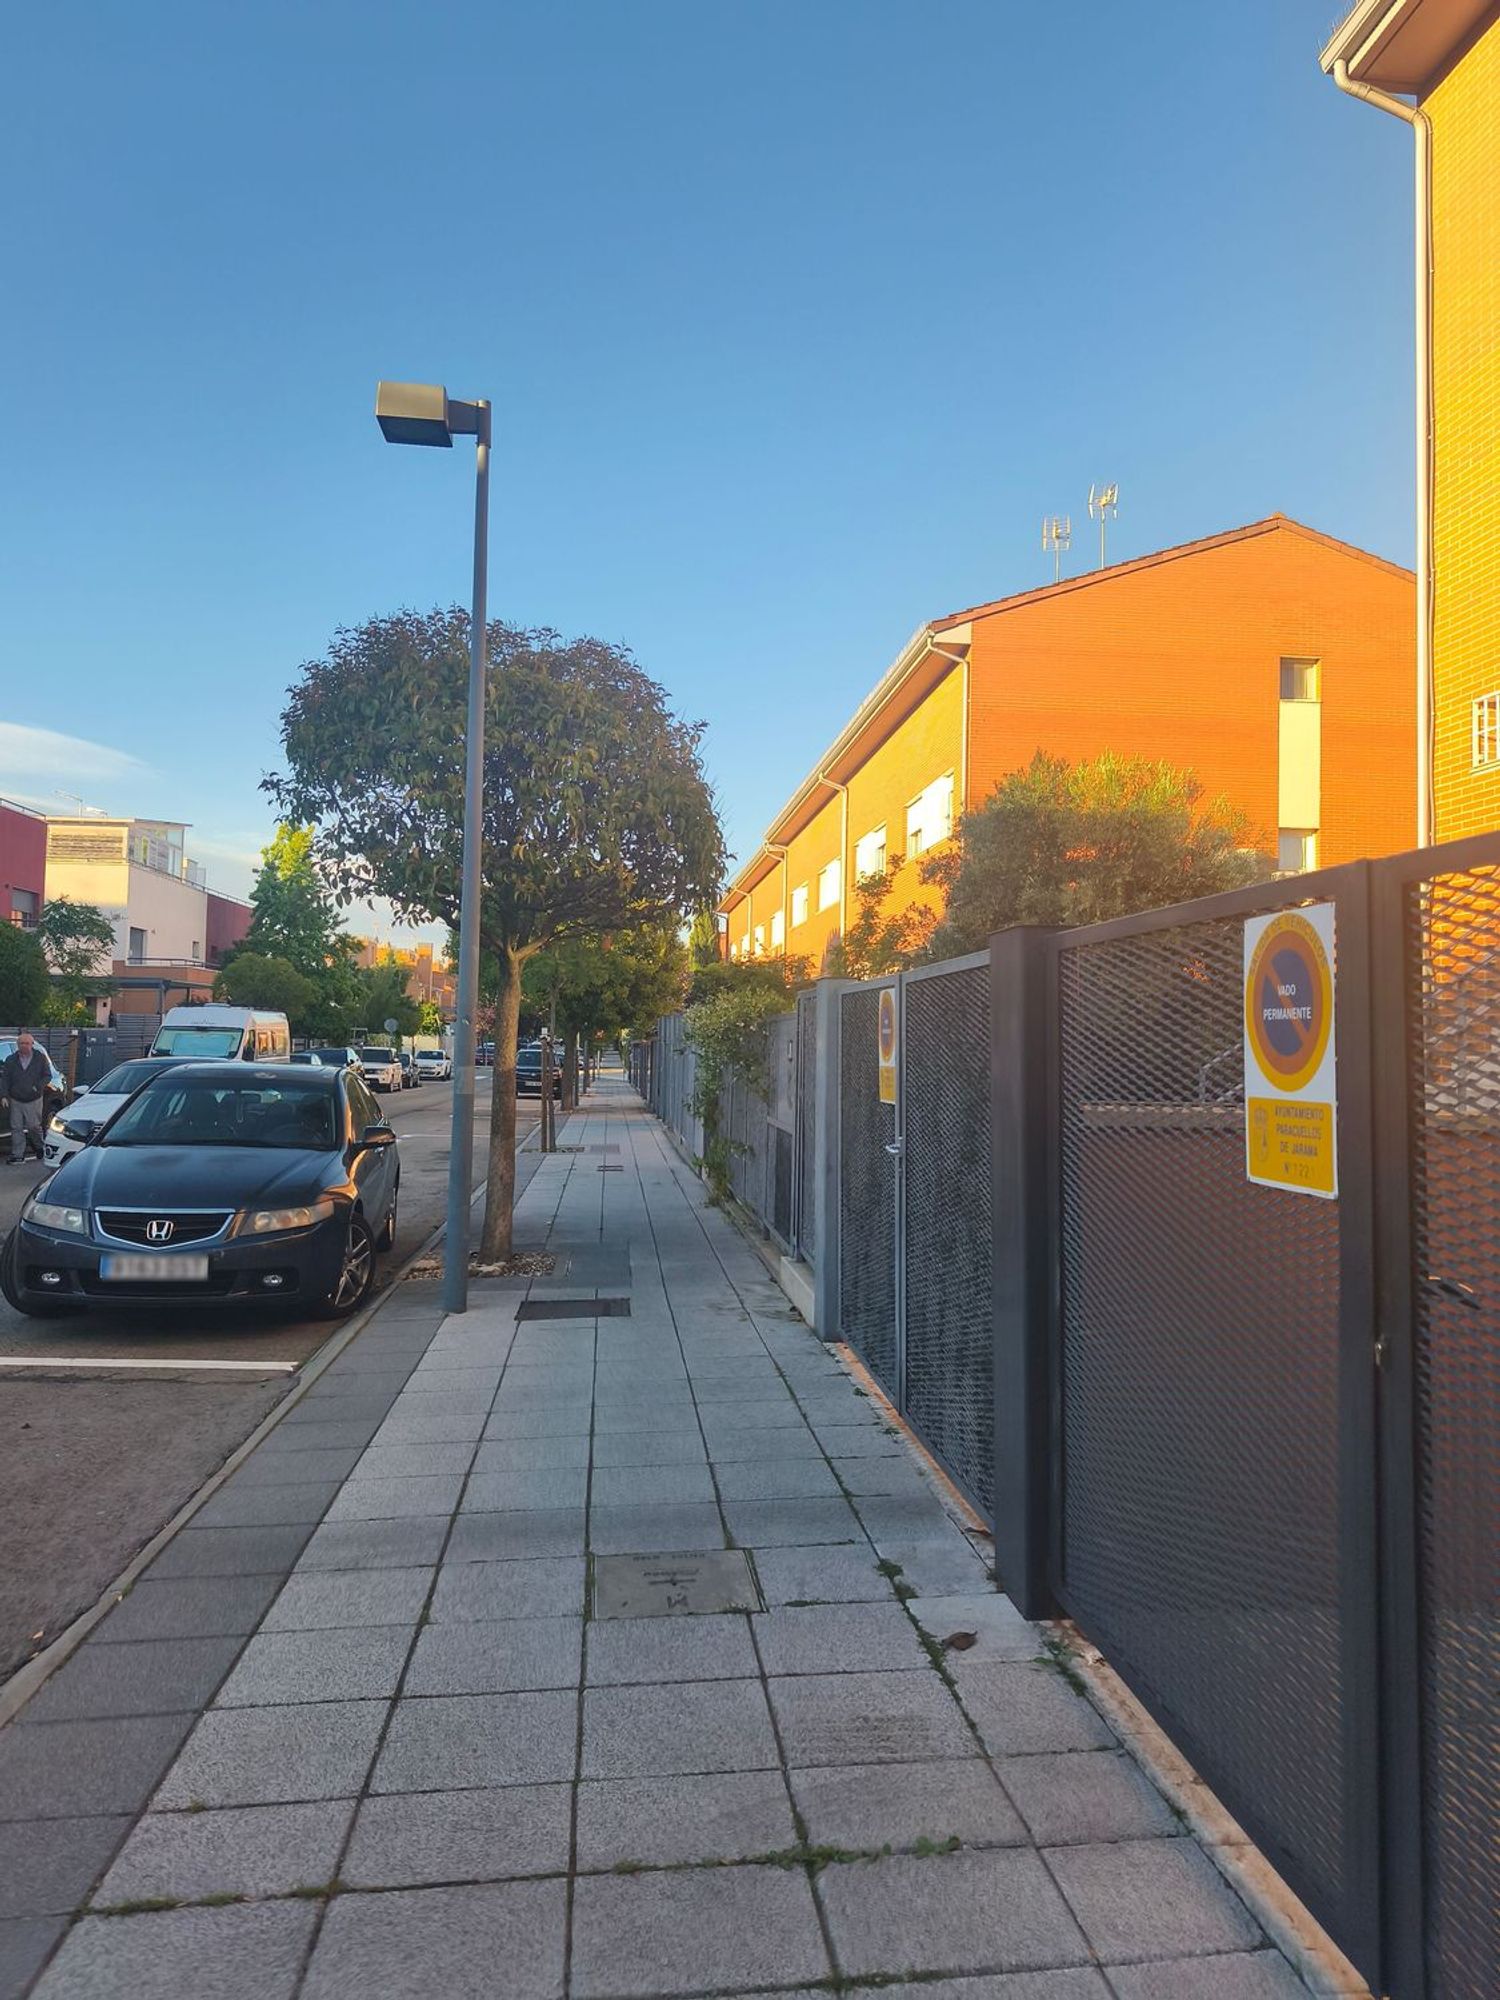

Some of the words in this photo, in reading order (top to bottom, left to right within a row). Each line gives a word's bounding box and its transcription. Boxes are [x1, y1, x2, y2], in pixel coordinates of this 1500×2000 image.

[1277, 983, 1296, 996] VADO
[1263, 1007, 1312, 1020] PERMANENTE
[1280, 1141, 1289, 1153] DE
